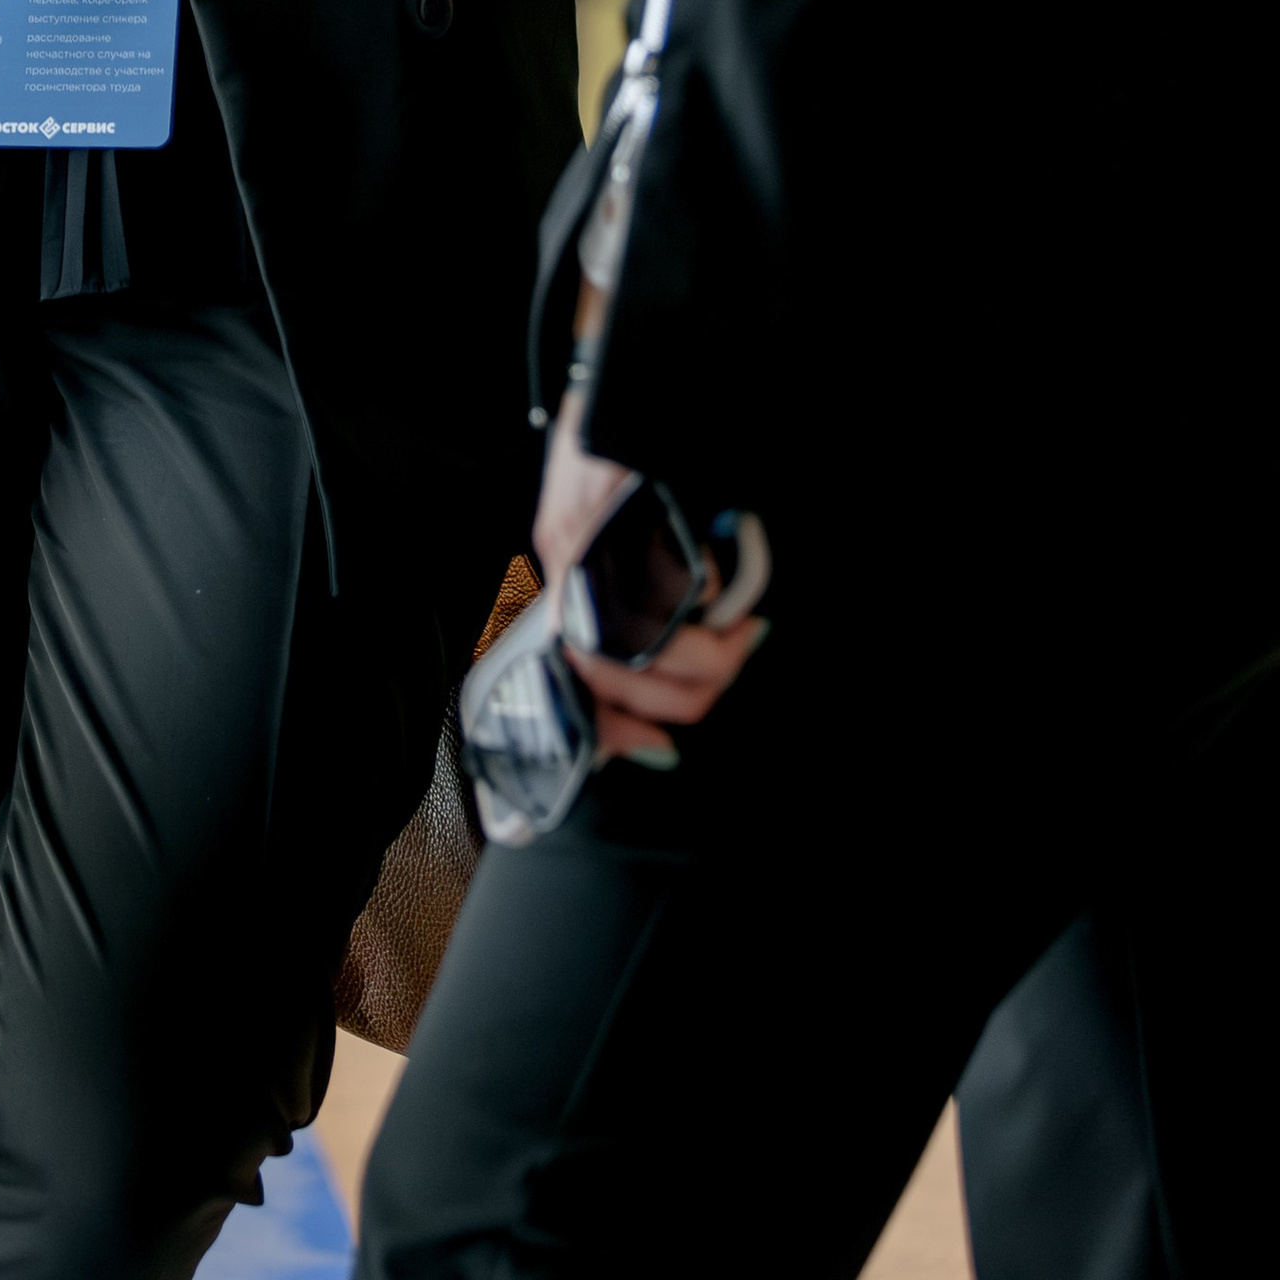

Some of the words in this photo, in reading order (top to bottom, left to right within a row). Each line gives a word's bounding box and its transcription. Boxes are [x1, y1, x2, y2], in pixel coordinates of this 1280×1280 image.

[28, 15, 100, 24] выступление
[102, 15, 148, 24] спикера
[27, 34, 111, 43] расследование
[26, 51, 95, 59] несчастного
[97, 51, 135, 60] случая
[138, 51, 151, 59] на
[25, 67, 102, 77] производстве
[104, 67, 111, 75] с
[114, 67, 165, 77] участием
[24, 83, 107, 93] госинспектора
[110, 83, 141, 93] труда
[62, 122, 116, 134] СЕРВИС
